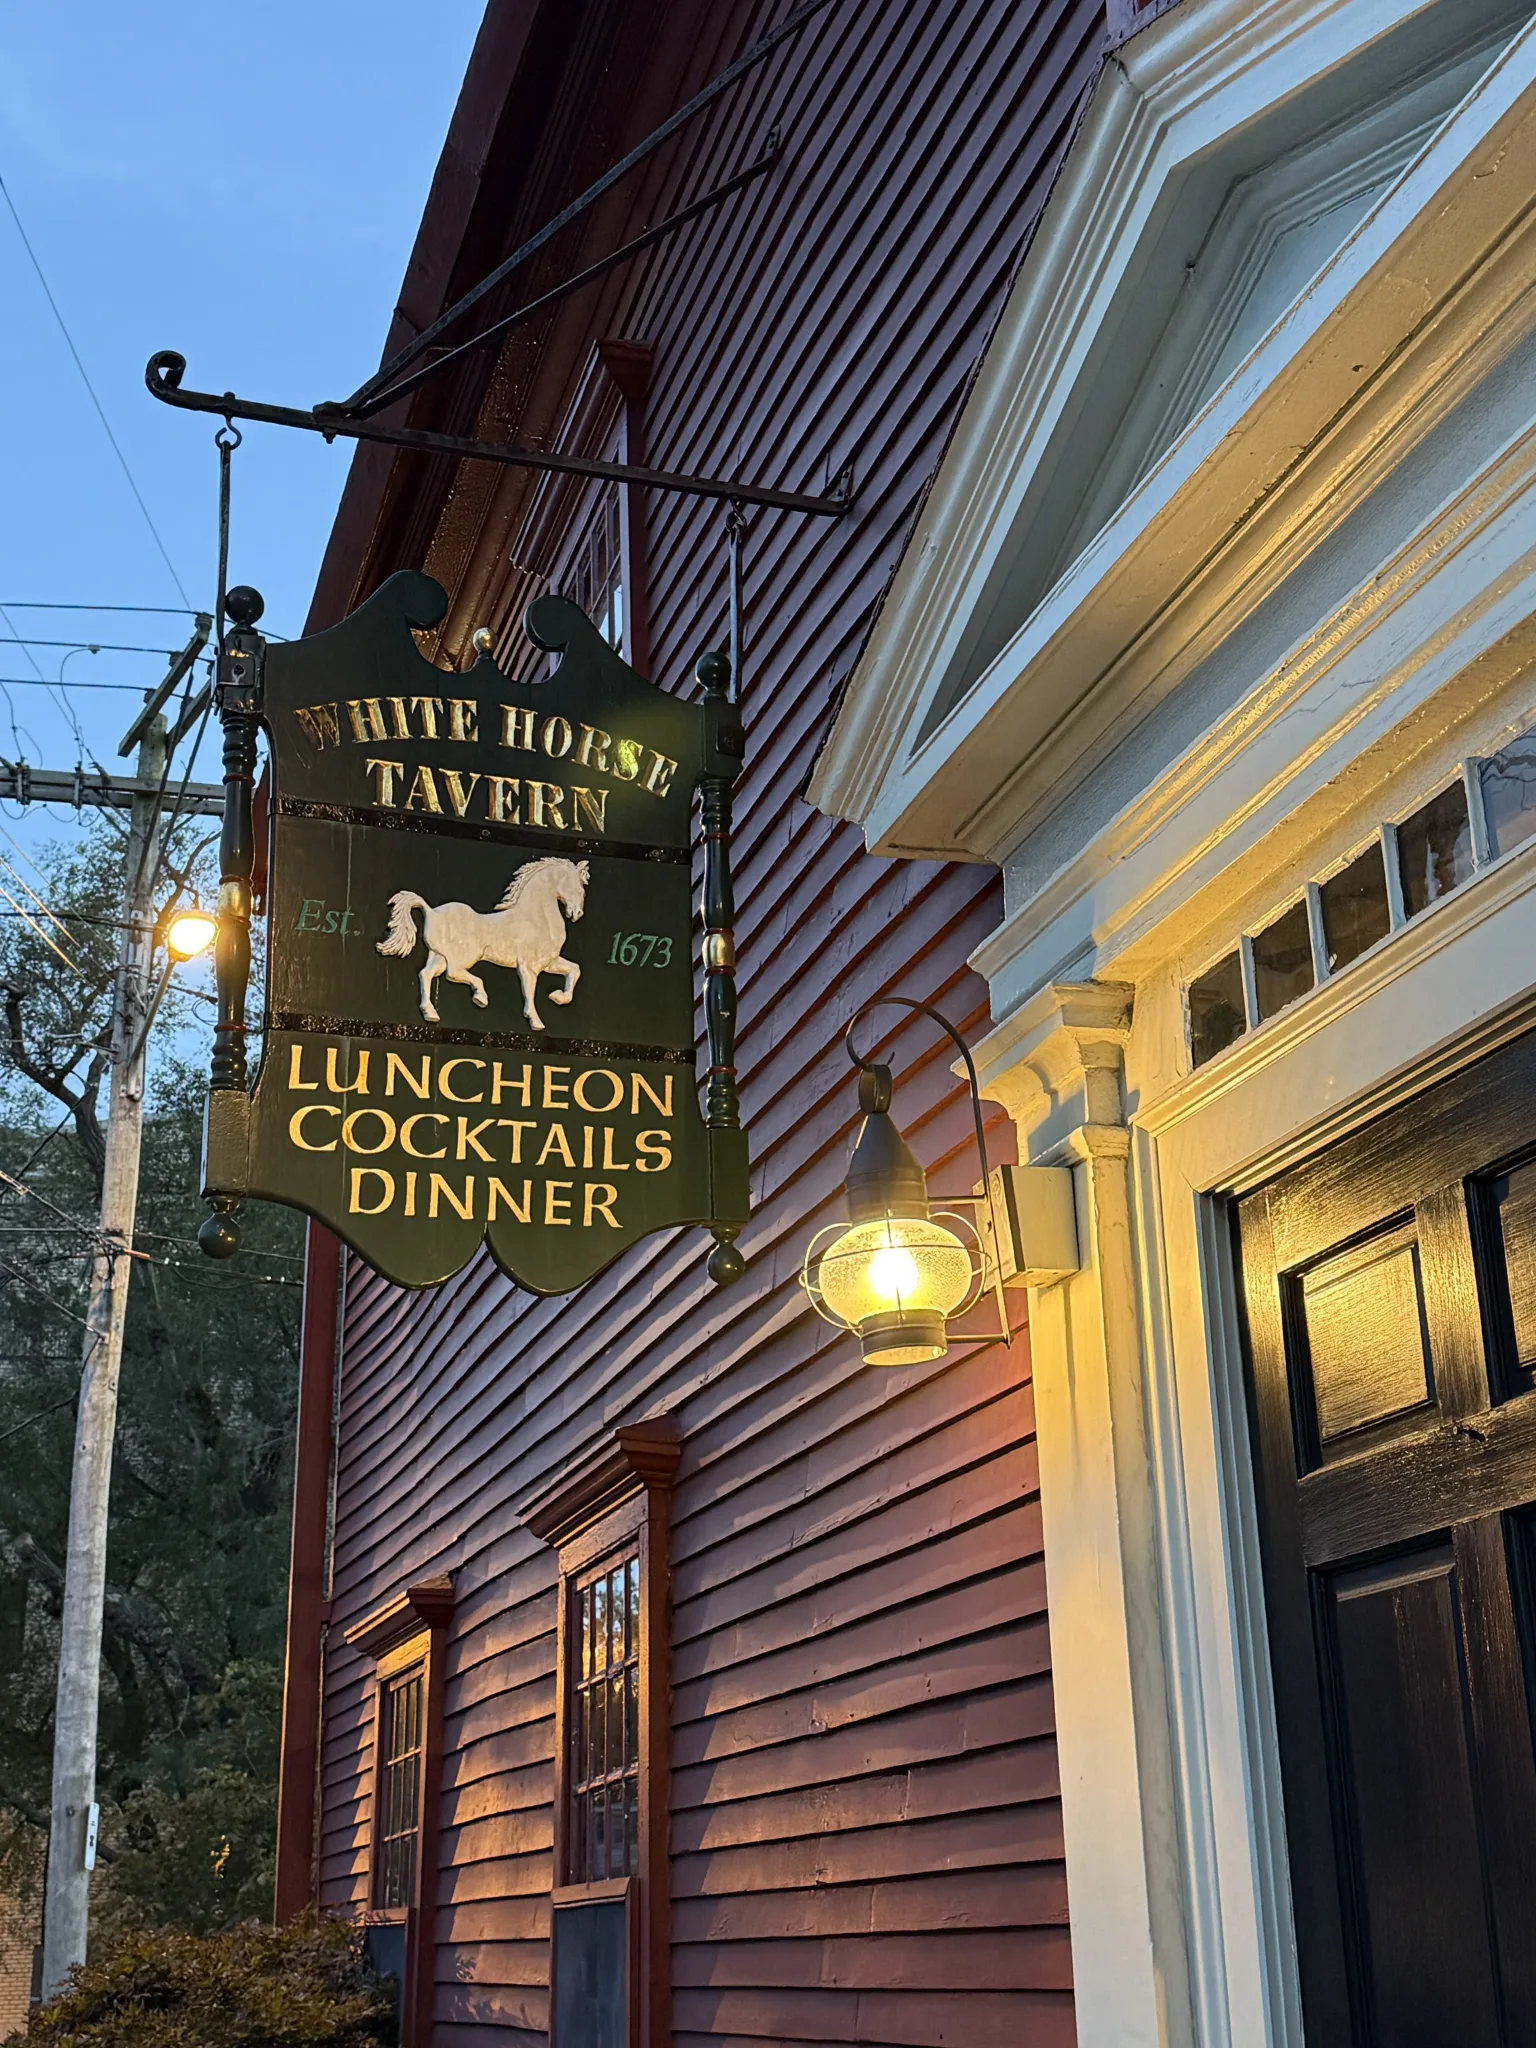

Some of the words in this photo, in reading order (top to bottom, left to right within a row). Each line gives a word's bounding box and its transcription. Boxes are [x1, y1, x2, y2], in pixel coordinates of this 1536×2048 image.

[294, 696, 480, 751] WHITE
[499, 704, 678, 799] HORSE
[366, 758, 610, 834] TAVERN
[295, 898, 361, 936] Est.
[608, 933, 673, 968] 1673
[288, 1044, 674, 1117] LUNCHEON
[288, 1104, 673, 1173] COCKTAILS
[348, 1167, 623, 1228] DINNER
